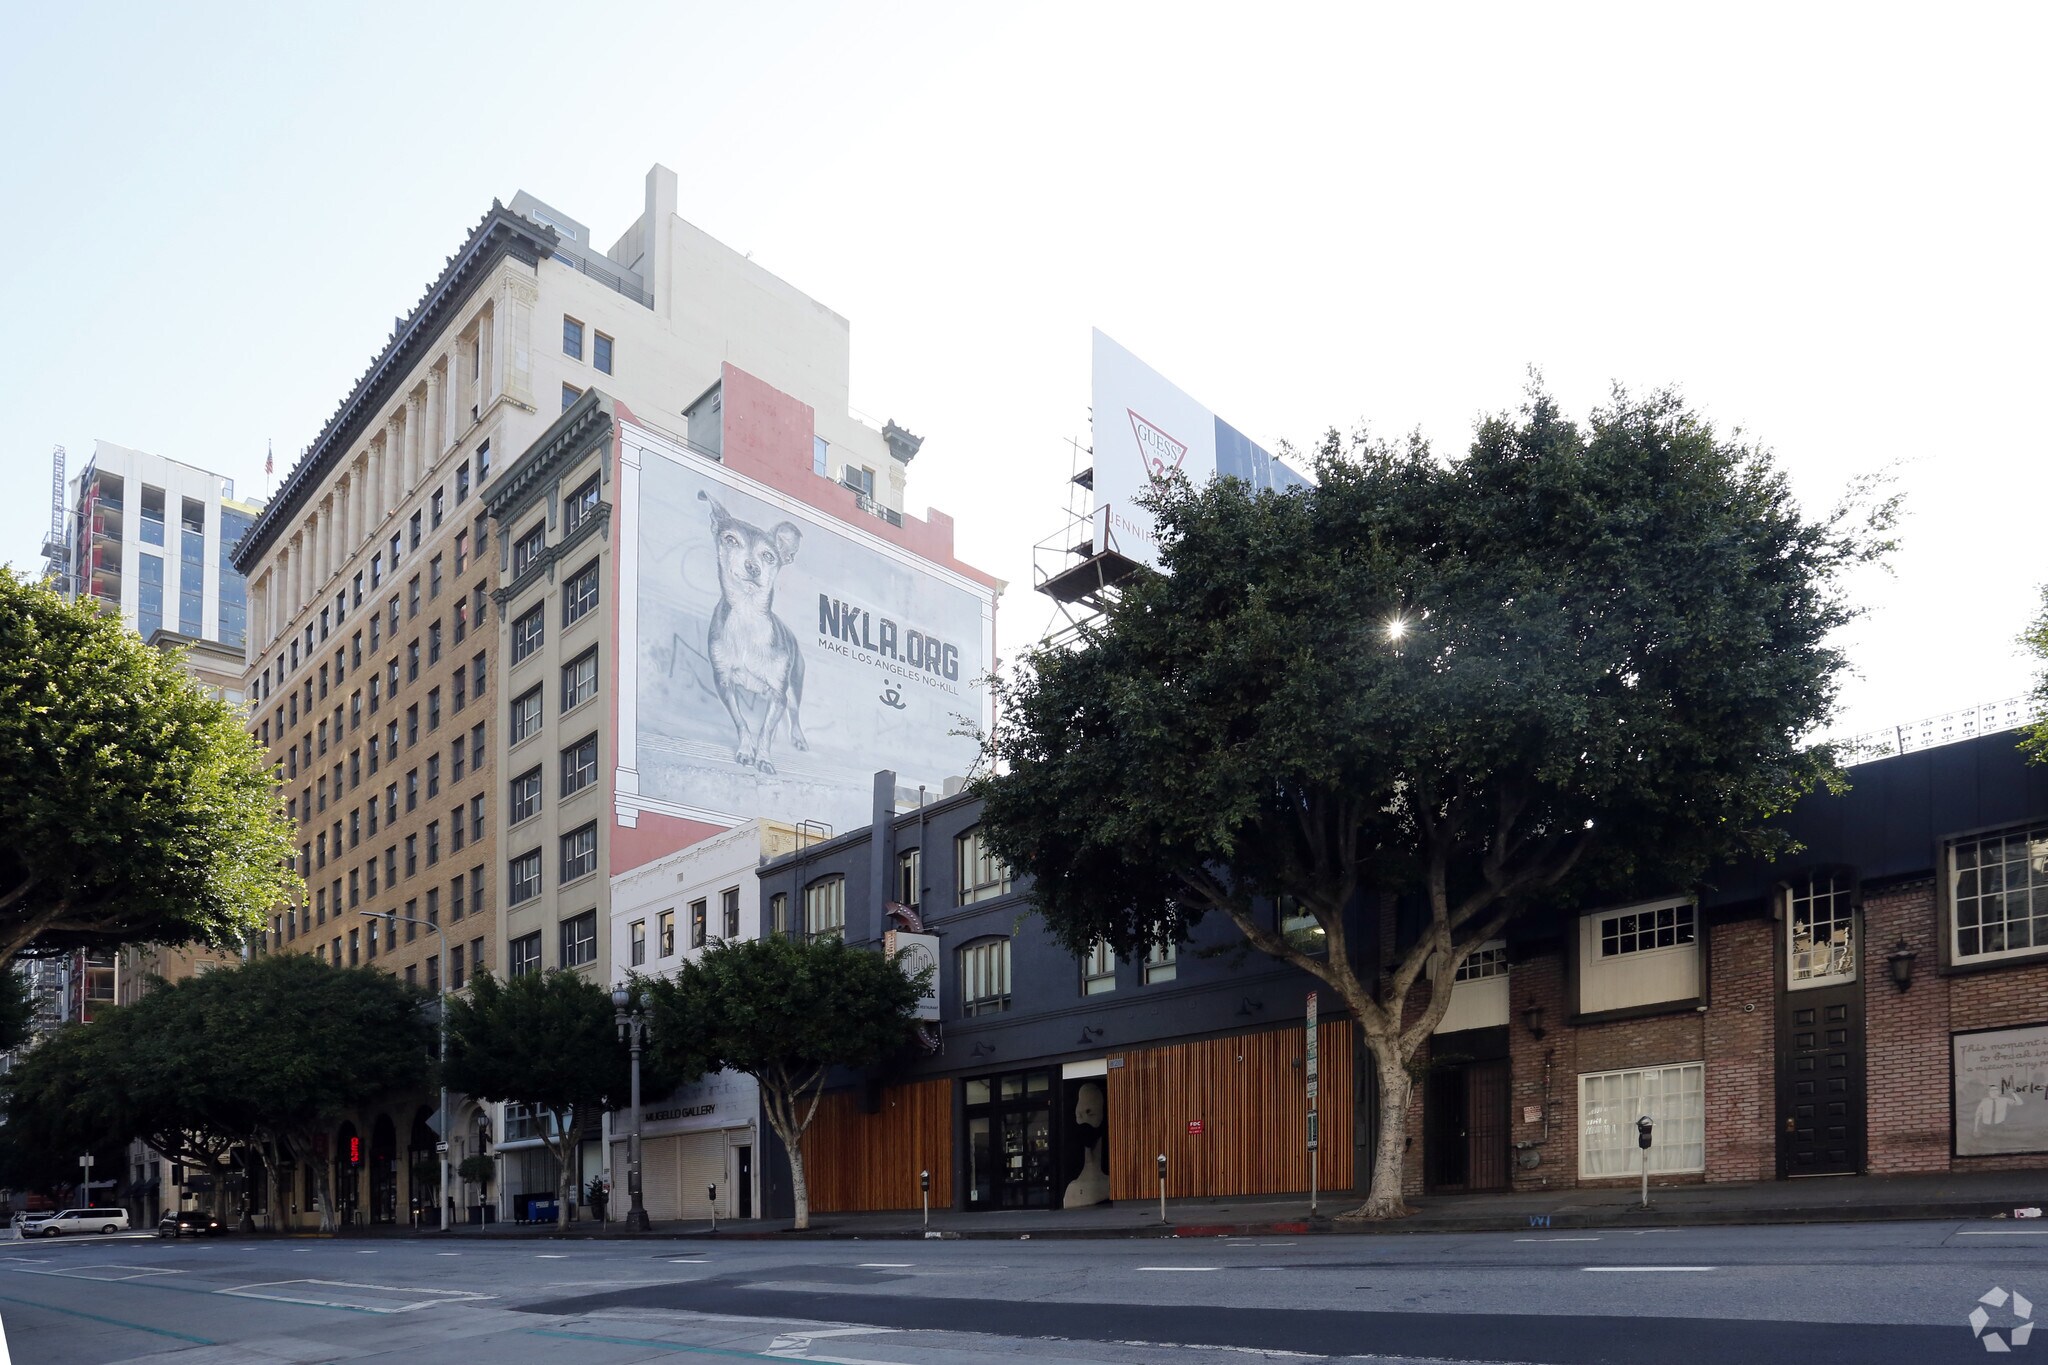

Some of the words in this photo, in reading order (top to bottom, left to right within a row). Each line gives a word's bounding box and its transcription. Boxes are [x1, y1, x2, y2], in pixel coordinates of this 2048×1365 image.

[1137, 424, 1177, 461] GUESS
[819, 593, 959, 682] NKLA.ORG
[818, 638, 849, 657] MAKE
[851, 650, 872, 665] LOS
[874, 659, 920, 682] ANGELES
[922, 675, 959, 696] NO-KILL
[1990, 1039, 2040, 1050] moment
[682, 1104, 716, 1118] GALLERY
